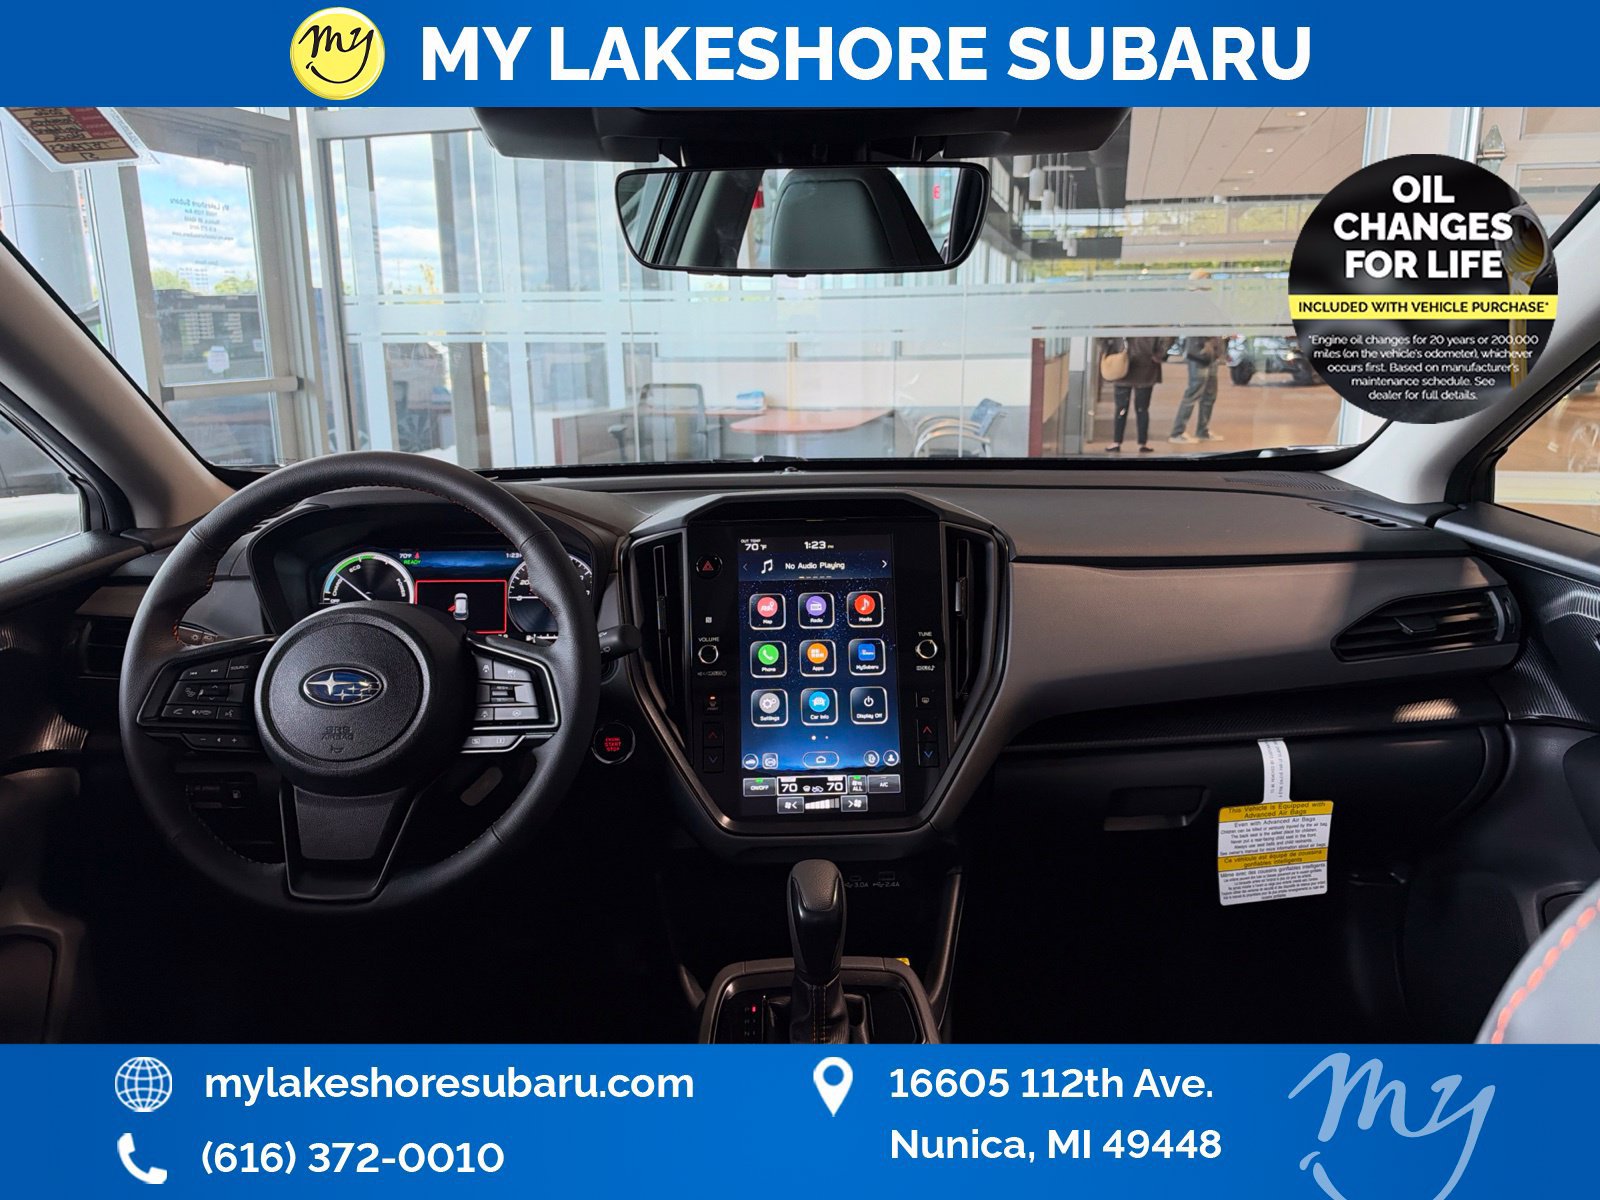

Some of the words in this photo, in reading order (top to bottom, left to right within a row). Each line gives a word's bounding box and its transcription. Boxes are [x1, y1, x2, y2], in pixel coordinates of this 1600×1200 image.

[745, 543, 759, 551] 70
[804, 540, 826, 549] 1:23
[819, 561, 845, 570] Playing
[780, 783, 798, 793] 70
[826, 781, 844, 791] 70
[1278, 802, 1310, 810] Equipped
